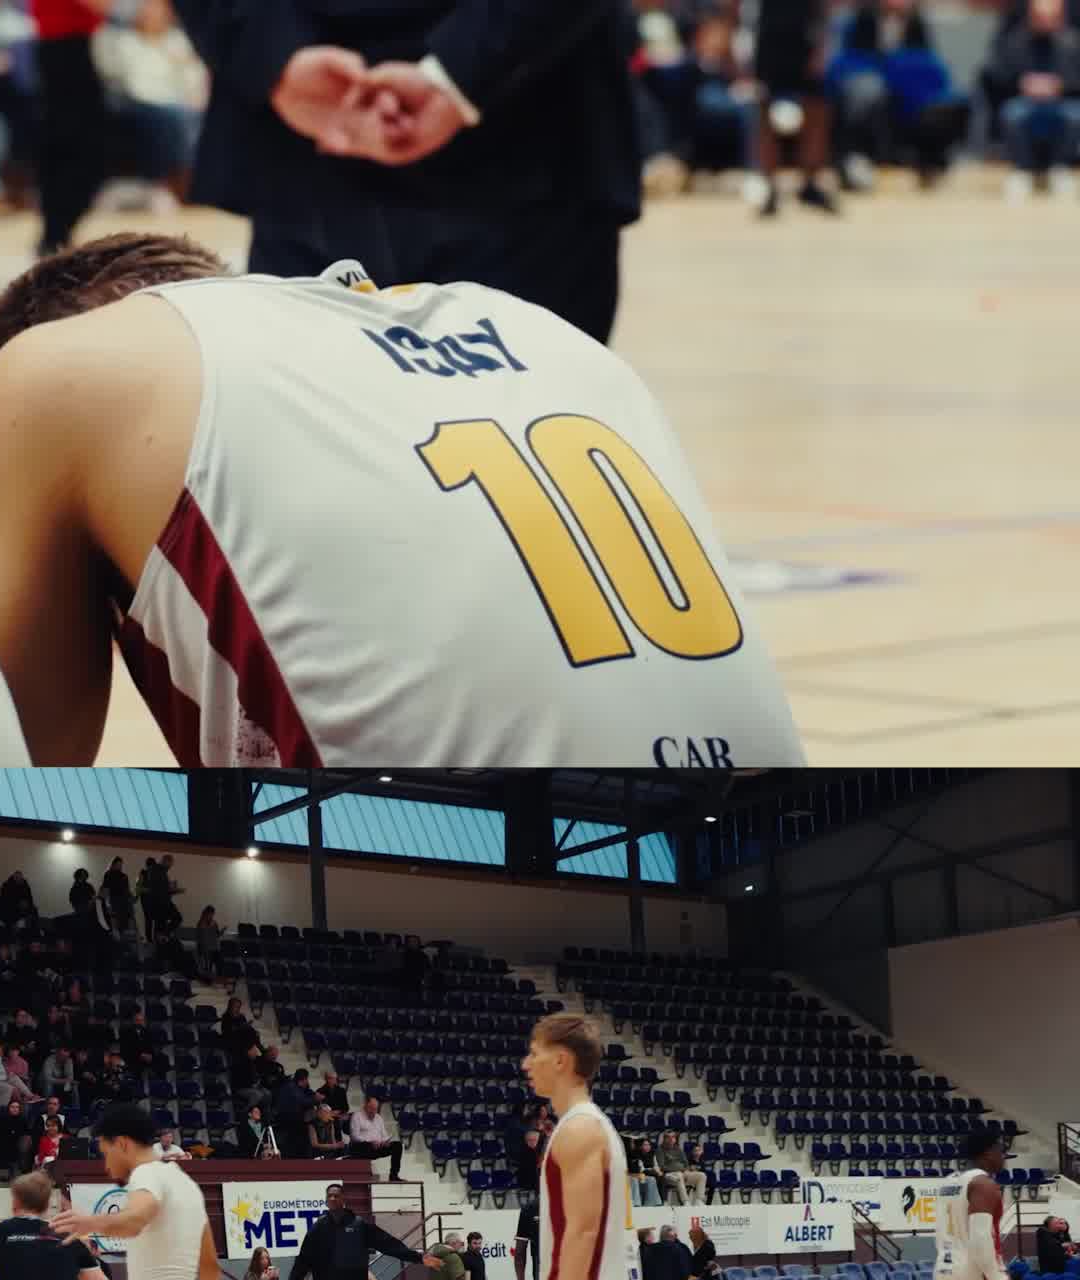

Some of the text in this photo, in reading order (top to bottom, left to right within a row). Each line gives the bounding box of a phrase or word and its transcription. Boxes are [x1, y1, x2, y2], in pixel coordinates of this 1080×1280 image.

[414, 413, 744, 668] 10
[244, 1210, 328, 1249] MET
[785, 1225, 834, 1243] ALBERT
